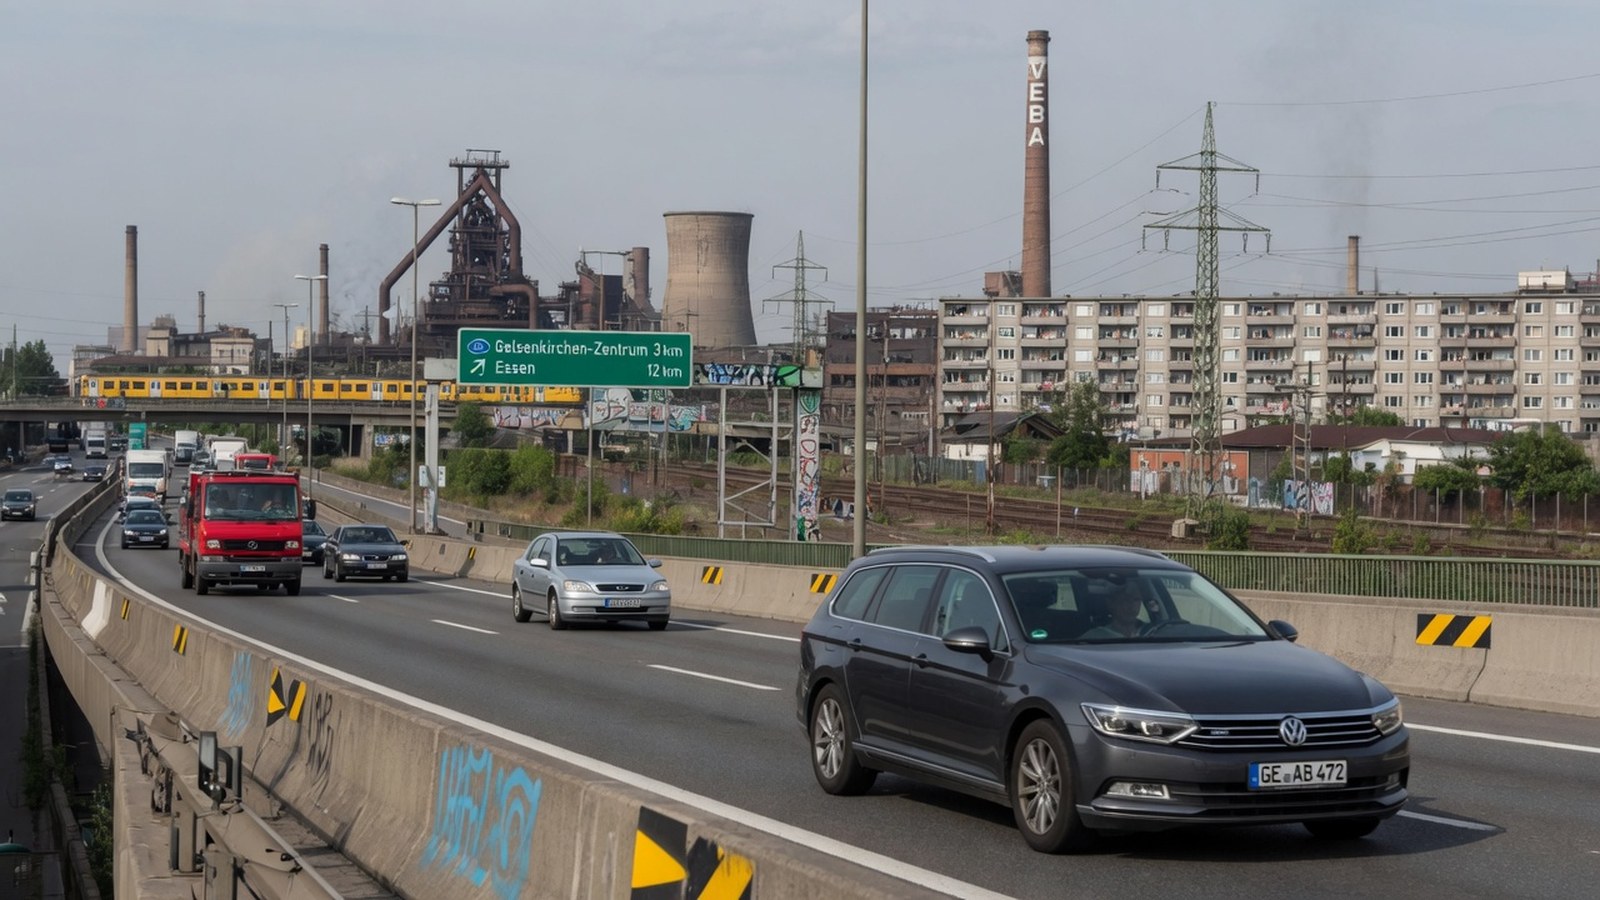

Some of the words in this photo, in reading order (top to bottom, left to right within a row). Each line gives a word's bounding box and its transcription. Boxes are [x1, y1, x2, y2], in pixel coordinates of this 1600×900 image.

[1028, 61, 1045, 147] VEBA
[495, 339, 648, 356] Gelsenkirchen-Zentrum
[653, 342, 661, 357] 3
[663, 344, 683, 358] km
[647, 363, 660, 377] 12
[662, 365, 682, 378] km
[1261, 765, 1282, 783] GE
[1293, 764, 1313, 782] AB
[1316, 763, 1344, 780] 472
